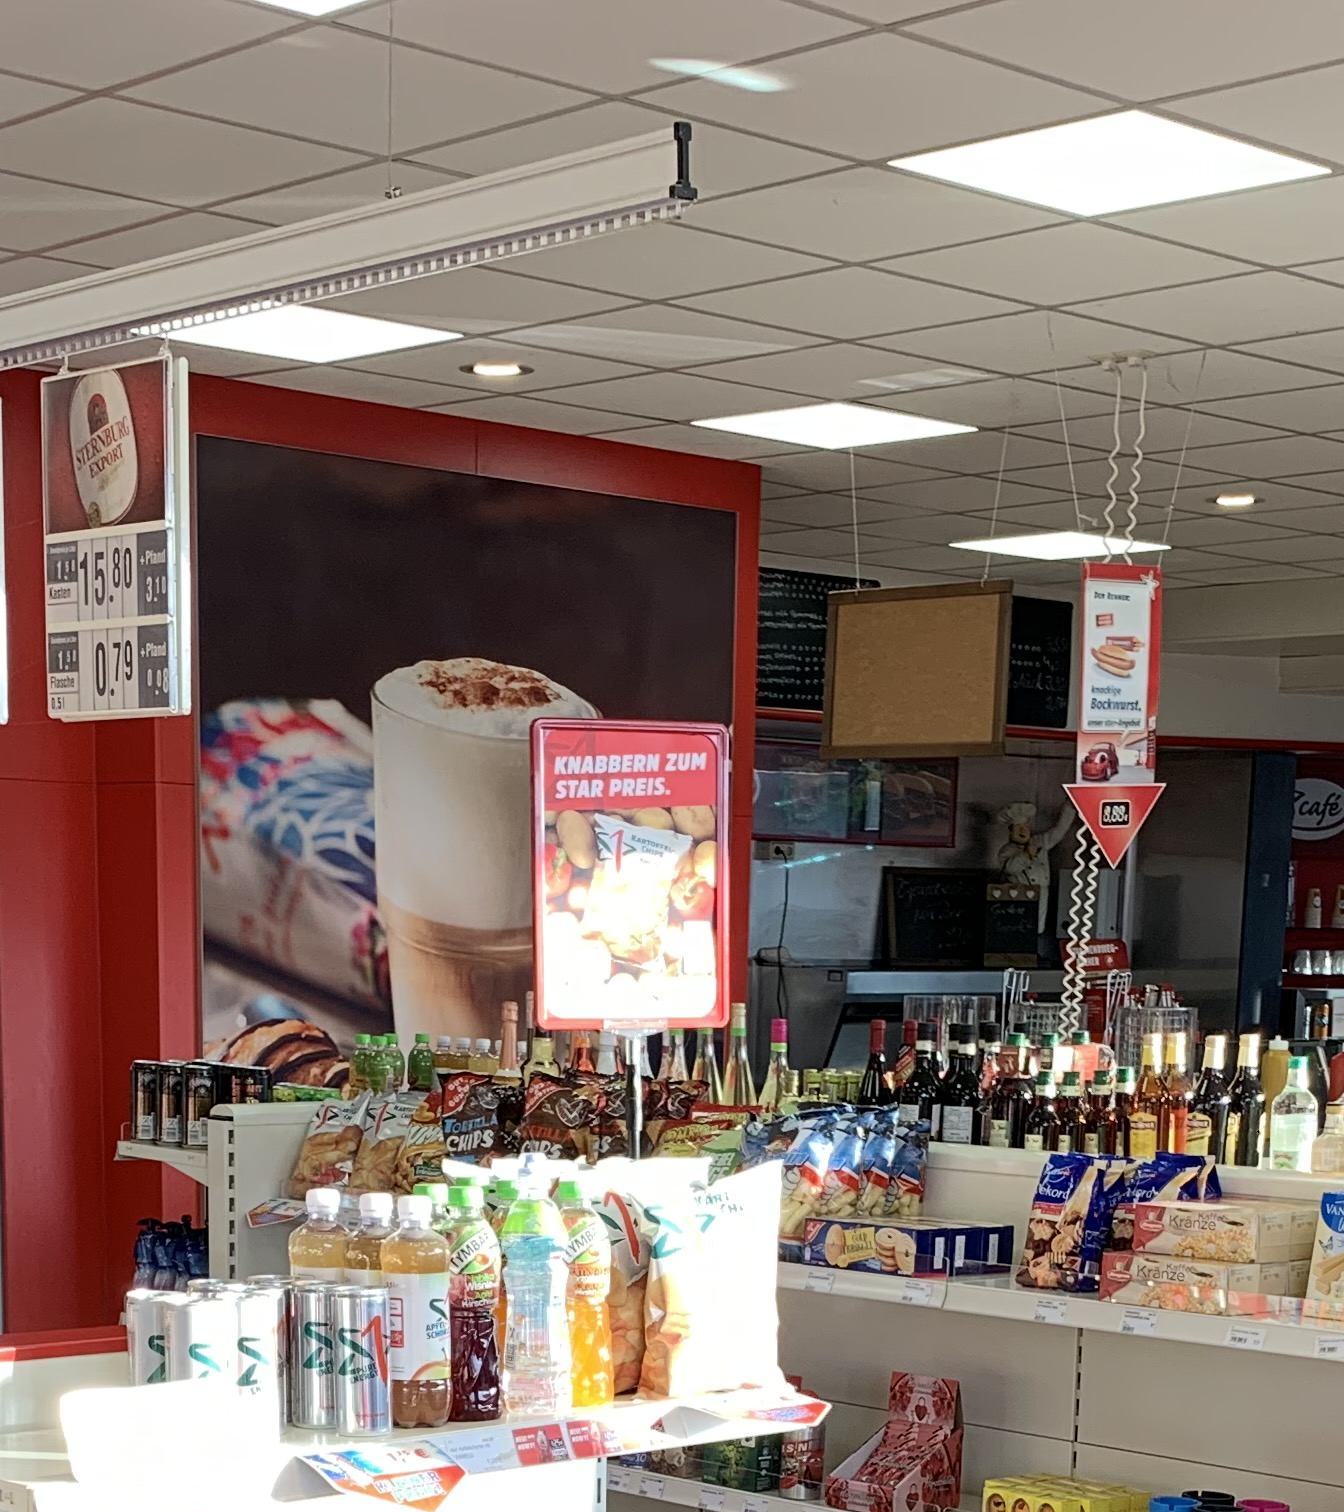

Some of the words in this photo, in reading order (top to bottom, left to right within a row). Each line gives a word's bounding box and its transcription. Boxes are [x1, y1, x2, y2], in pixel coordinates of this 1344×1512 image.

[75, 415, 131, 471] STERNBURG
[88, 443, 124, 479] EXPORT
[79, 547, 133, 606] 15.80
[49, 586, 72, 599] Kasten
[95, 640, 134, 697] 0.79
[50, 676, 76, 690] Flasche
[1090, 697, 1142, 711] Bockwurst.
[554, 753, 660, 775] KNABBERN
[664, 752, 707, 773] ZUM
[555, 779, 604, 799] STAR
[608, 777, 671, 798] PREIS.
[1298, 795, 1342, 823] café
[444, 1114, 498, 1133] TORTILLA
[445, 1129, 495, 1153] CHIPS
[1168, 1214, 1216, 1233] Kränze
[1136, 1263, 1185, 1283] Kränze
